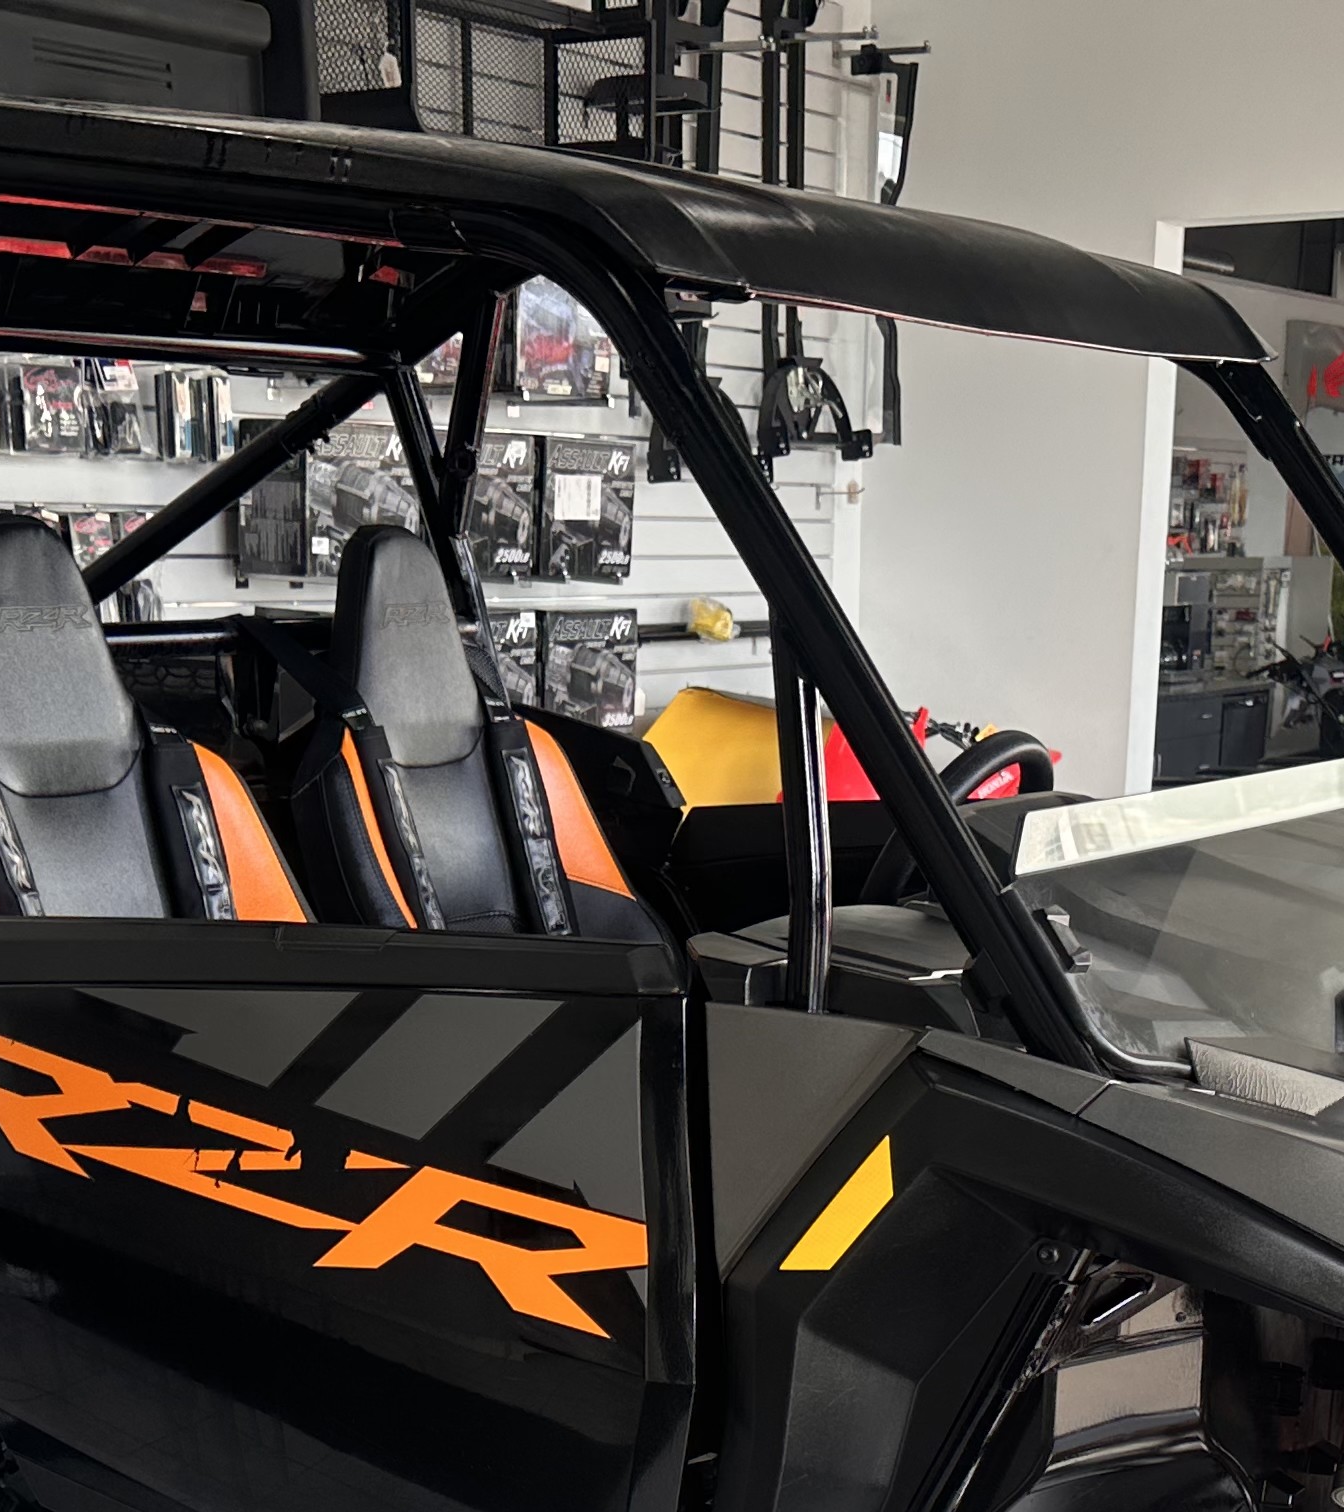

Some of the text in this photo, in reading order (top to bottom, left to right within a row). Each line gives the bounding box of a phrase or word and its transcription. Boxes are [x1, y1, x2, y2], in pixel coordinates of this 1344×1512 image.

[549, 444, 631, 475] ASSAULT KFI
[550, 615, 633, 642] ASSAULT KFI
